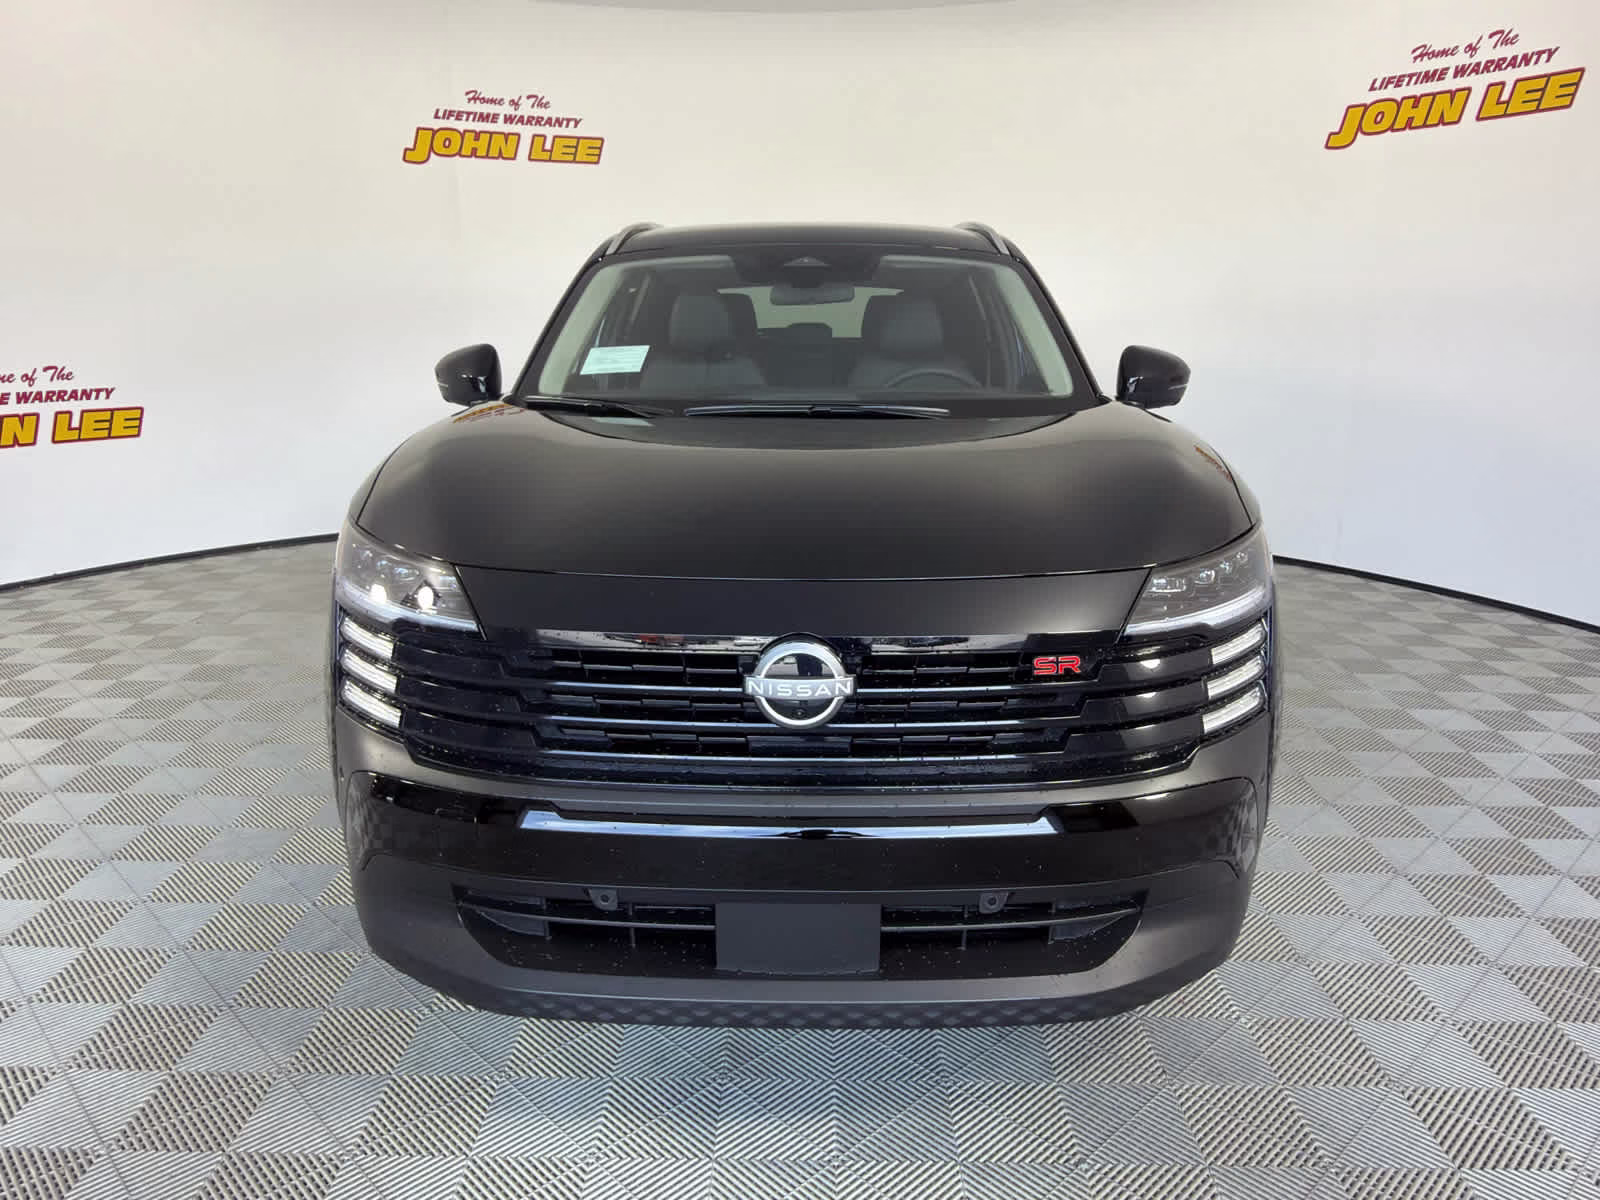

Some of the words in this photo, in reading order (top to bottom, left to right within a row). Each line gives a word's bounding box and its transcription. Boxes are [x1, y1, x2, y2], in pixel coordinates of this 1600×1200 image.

[1411, 43, 1458, 64] Home
[1464, 36, 1483, 58] of
[1488, 28, 1519, 50] The
[1368, 66, 1450, 92] LIFETIME
[1452, 46, 1560, 79] WARRANTY
[464, 90, 505, 106] Home
[508, 96, 522, 110] of
[526, 94, 550, 109] The
[1325, 86, 1472, 150] JOHN
[1475, 67, 1585, 122] LEE
[433, 108, 499, 124] LIFETIME
[503, 113, 582, 129] WARRANTY
[402, 126, 520, 165] JOHN
[528, 134, 604, 165] LEE
[20, 368, 37, 387] of
[42, 365, 74, 382] The
[16, 387, 115, 404] WARRANTY
[51, 406, 144, 444] LEE
[1033, 655, 1081, 676] SR
[748, 680, 852, 697] NISSAN
